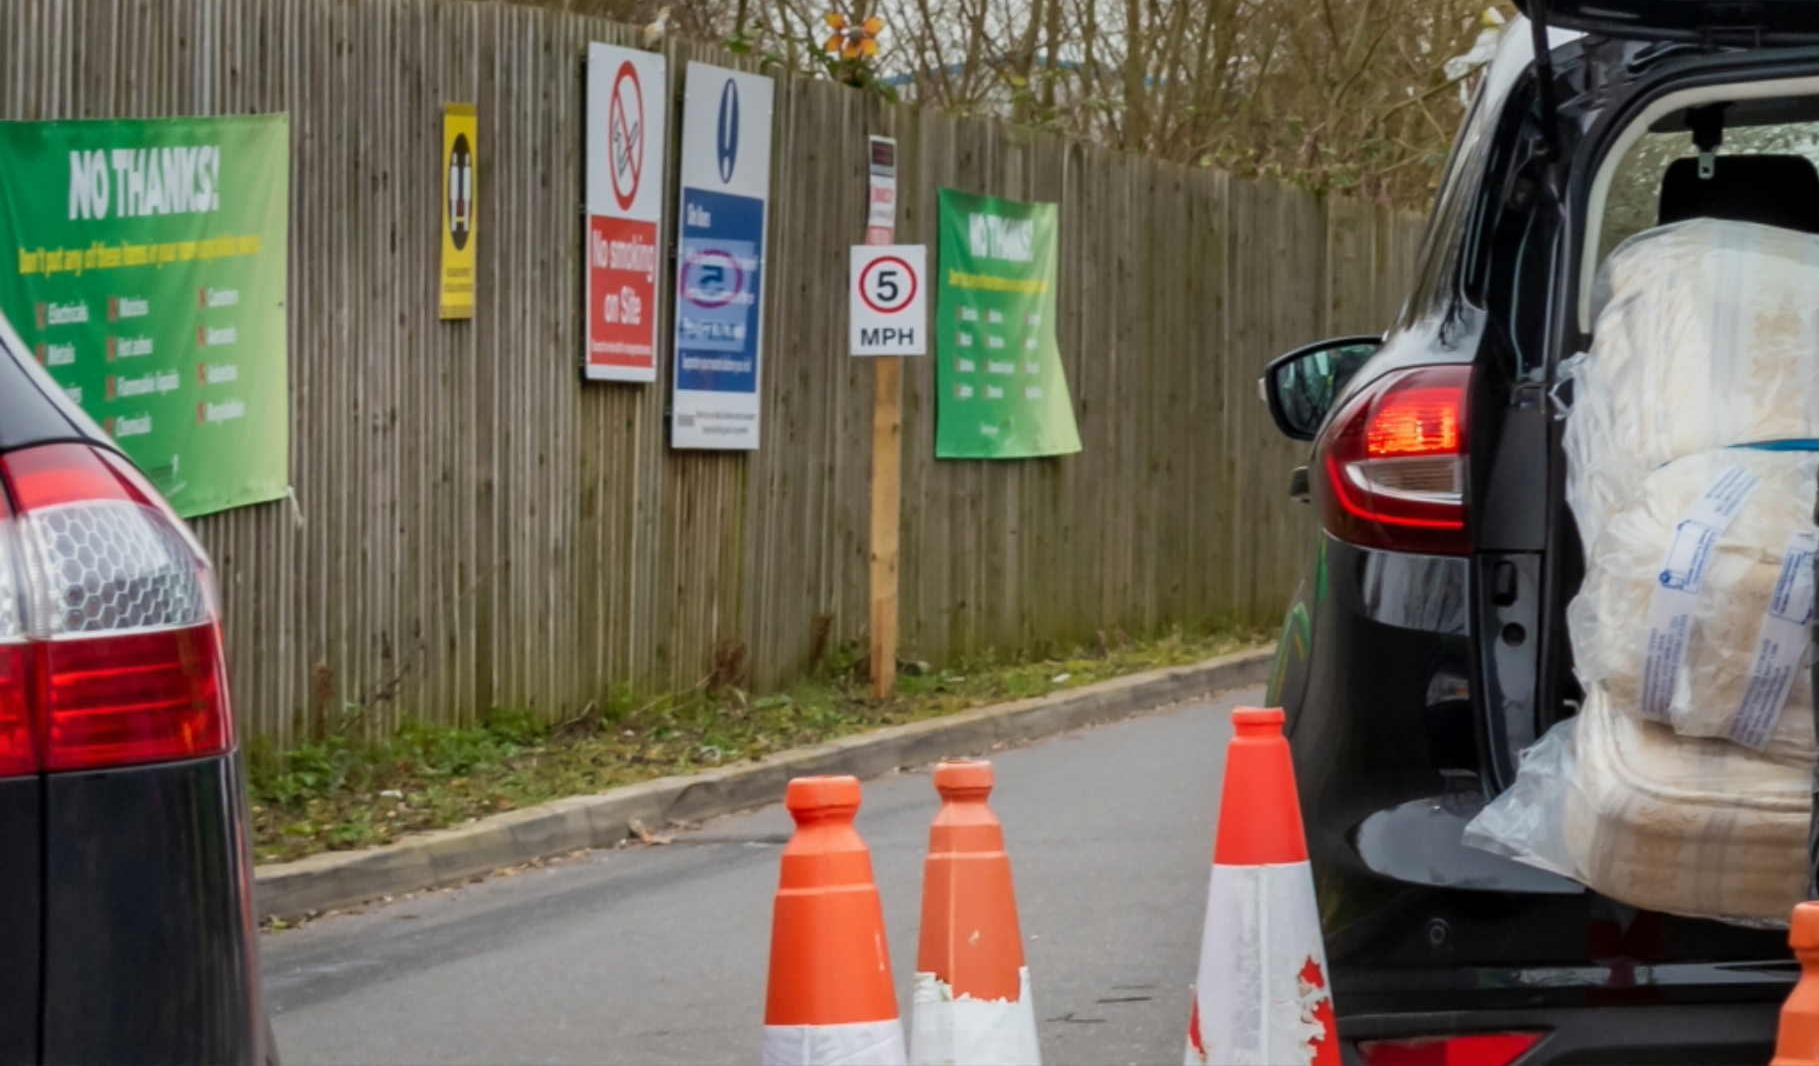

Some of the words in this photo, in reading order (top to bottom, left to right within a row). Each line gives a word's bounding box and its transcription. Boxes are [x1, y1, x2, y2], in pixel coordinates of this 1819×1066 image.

[69, 148, 109, 220] NO
[112, 145, 220, 218] THANKS!
[593, 229, 609, 268] No
[610, 234, 655, 283] smoking
[604, 294, 619, 323] on
[620, 285, 642, 325] Site
[876, 271, 898, 302] 5
[861, 328, 914, 346] MPH
